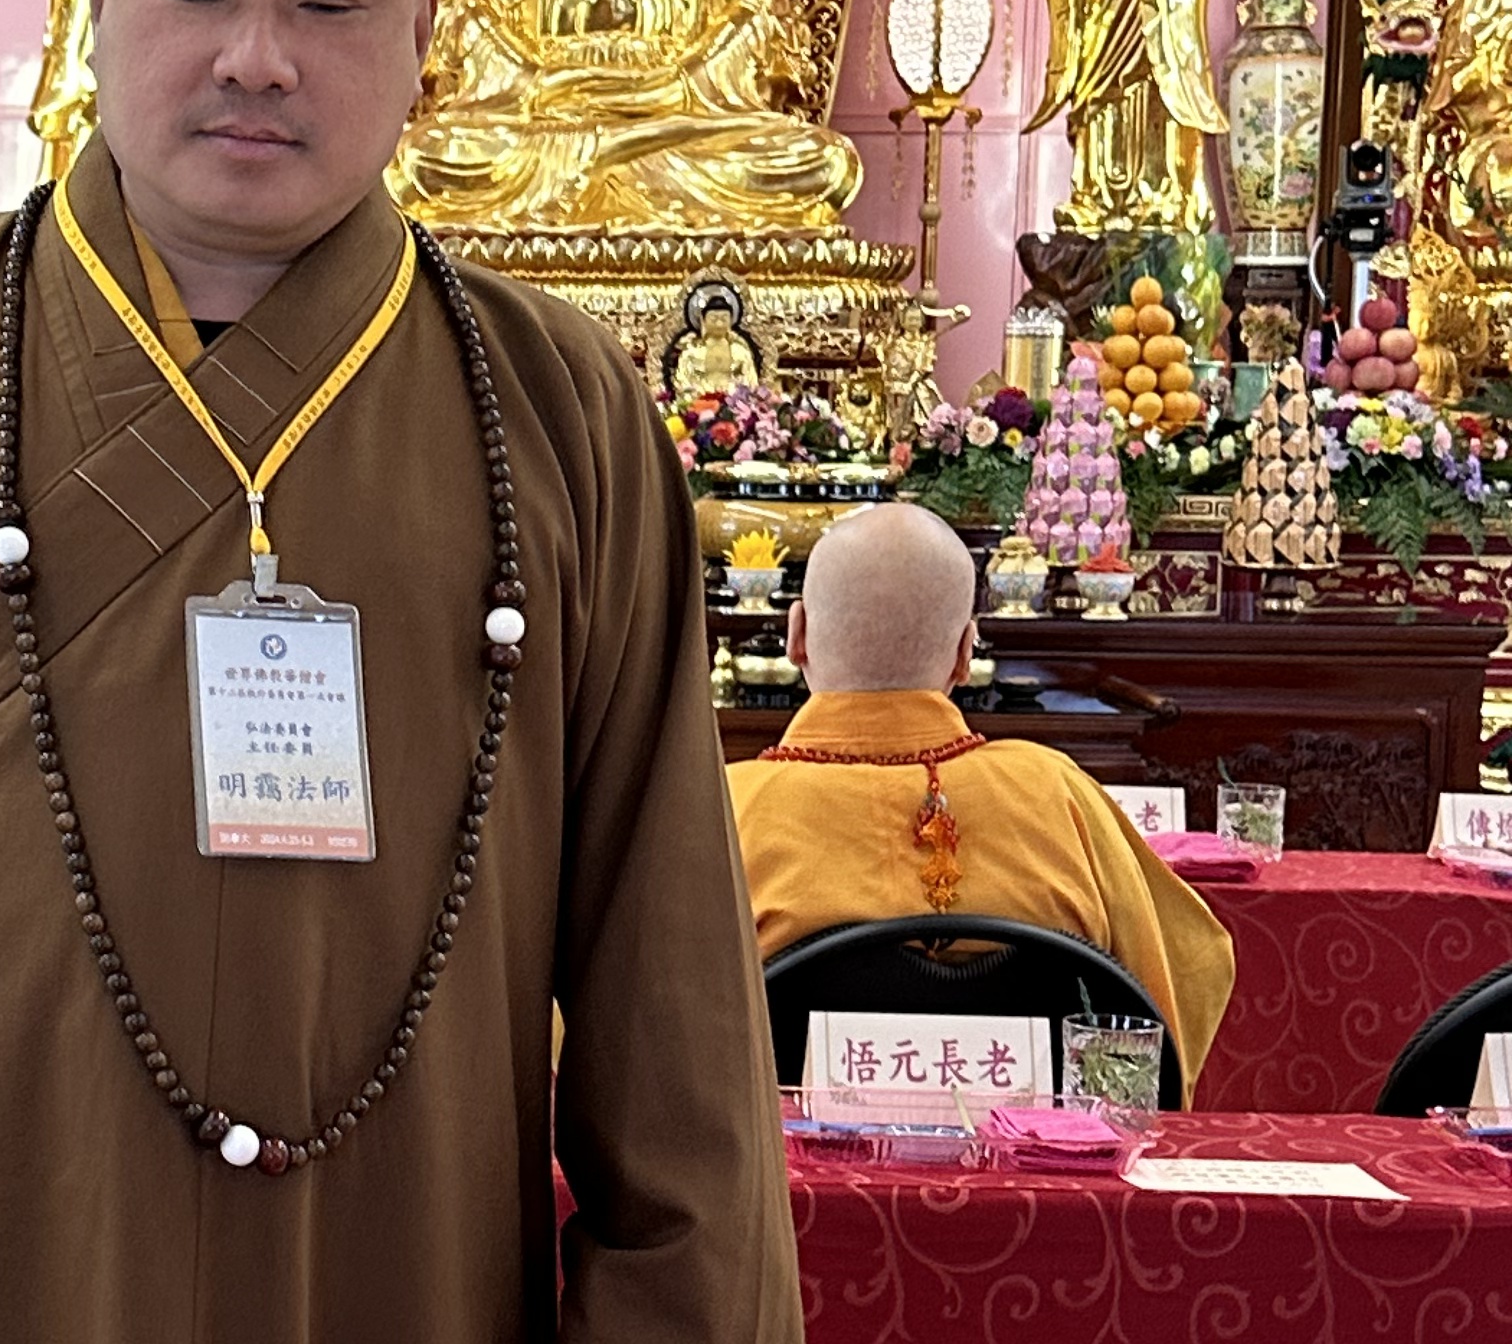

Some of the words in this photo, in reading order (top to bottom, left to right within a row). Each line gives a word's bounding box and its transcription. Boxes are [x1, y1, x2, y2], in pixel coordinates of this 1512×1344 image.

[218, 772, 350, 804] 明靄法師
[841, 1037, 1018, 1088] 悟元長老
